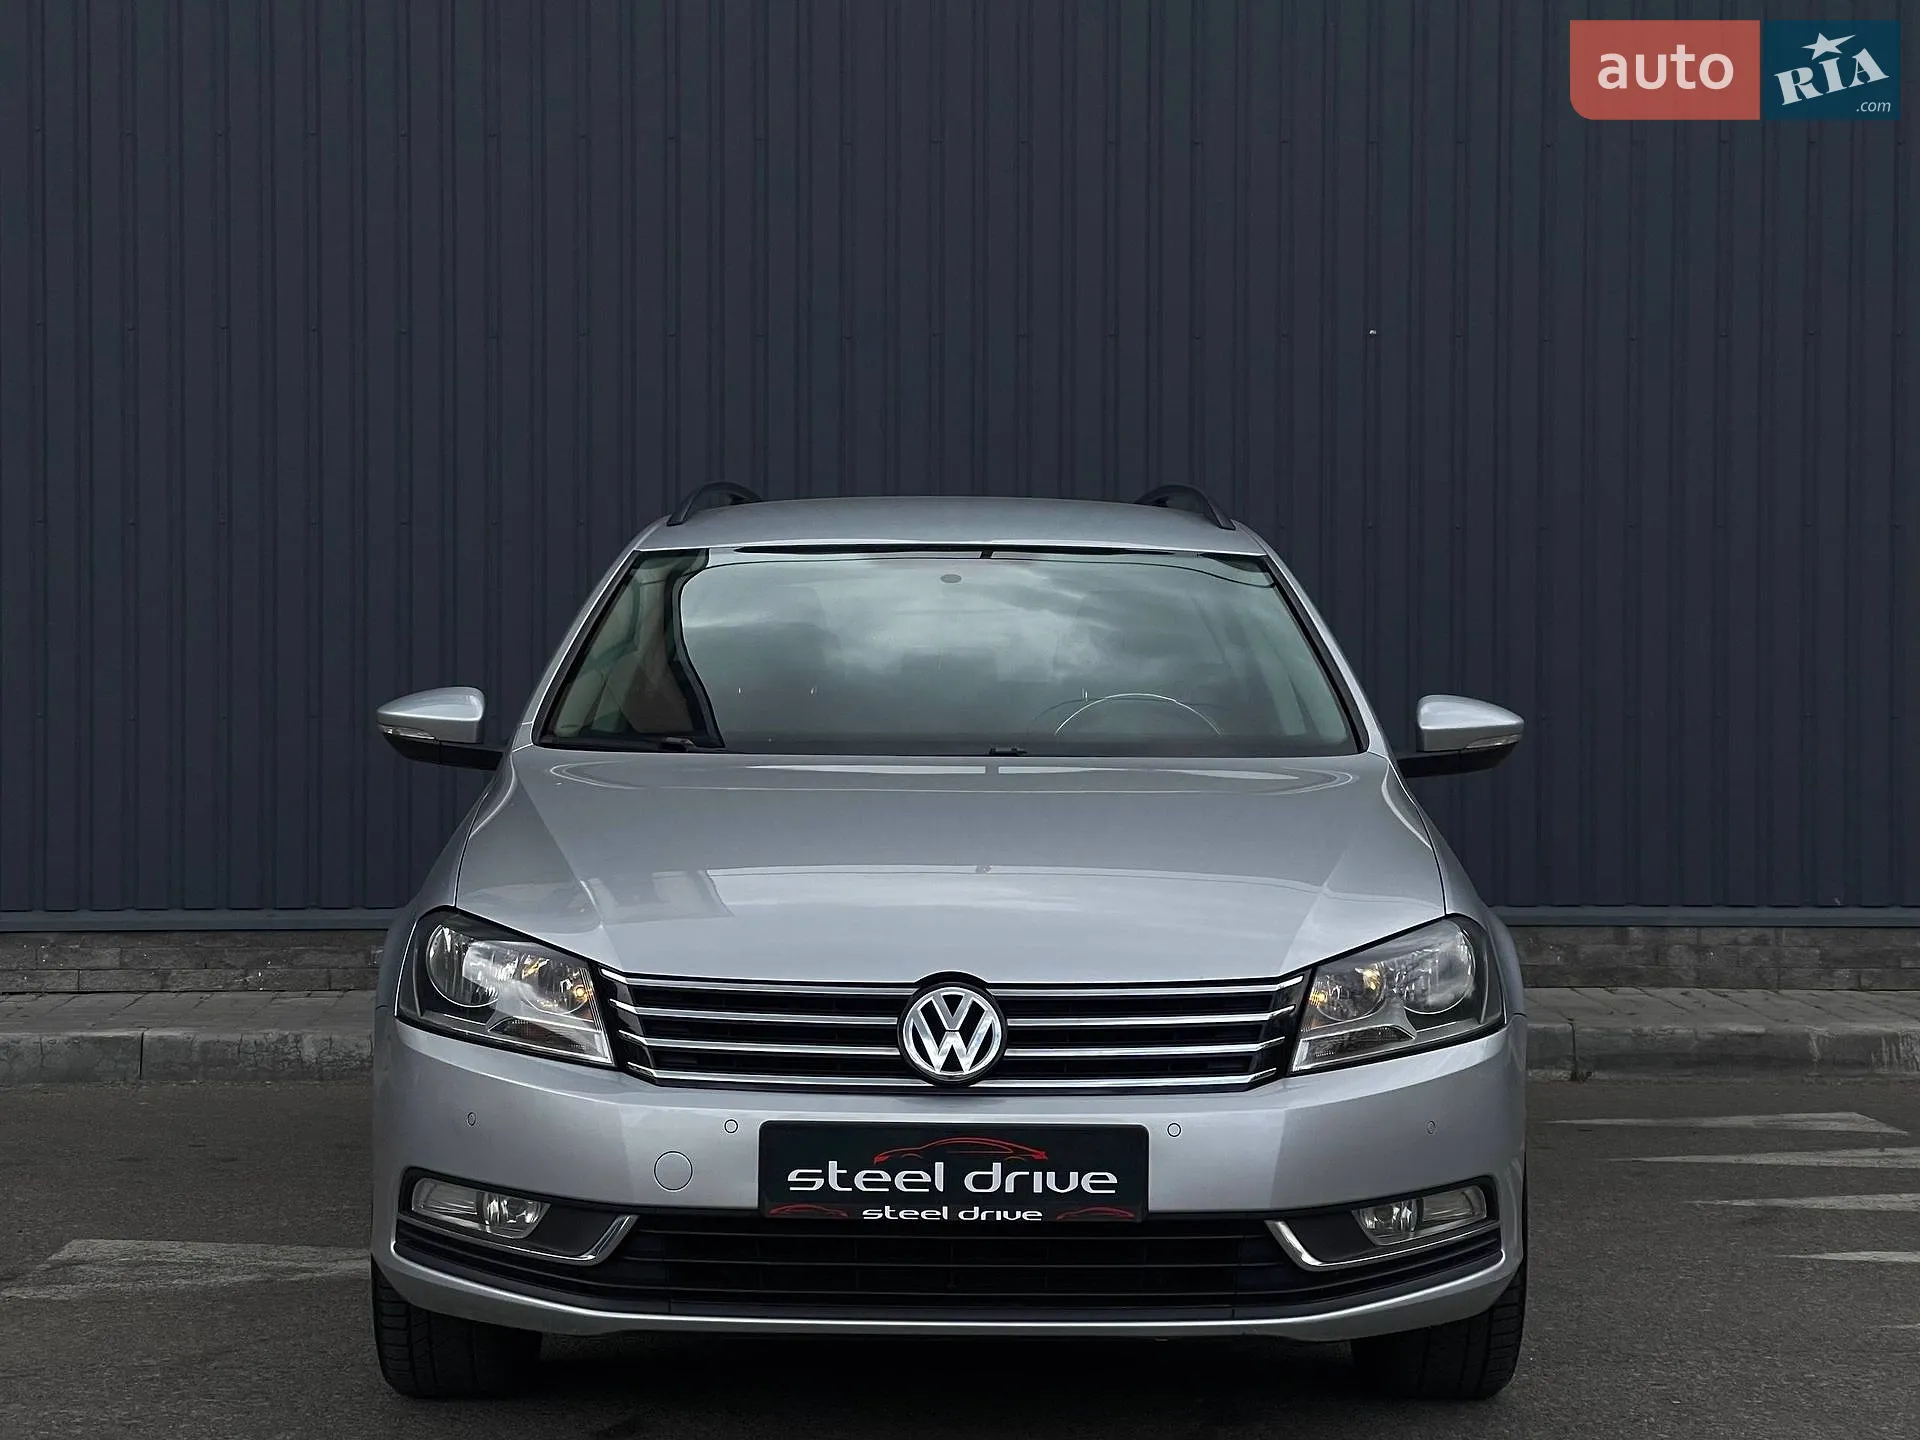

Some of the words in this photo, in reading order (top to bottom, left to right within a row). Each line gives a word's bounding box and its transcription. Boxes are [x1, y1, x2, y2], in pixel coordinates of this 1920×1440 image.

[907, 988, 998, 1076] VW
[787, 1161, 944, 1192] steel
[963, 1162, 1118, 1194] drive
[862, 1206, 948, 1221] steel
[958, 1206, 1043, 1221] drive
